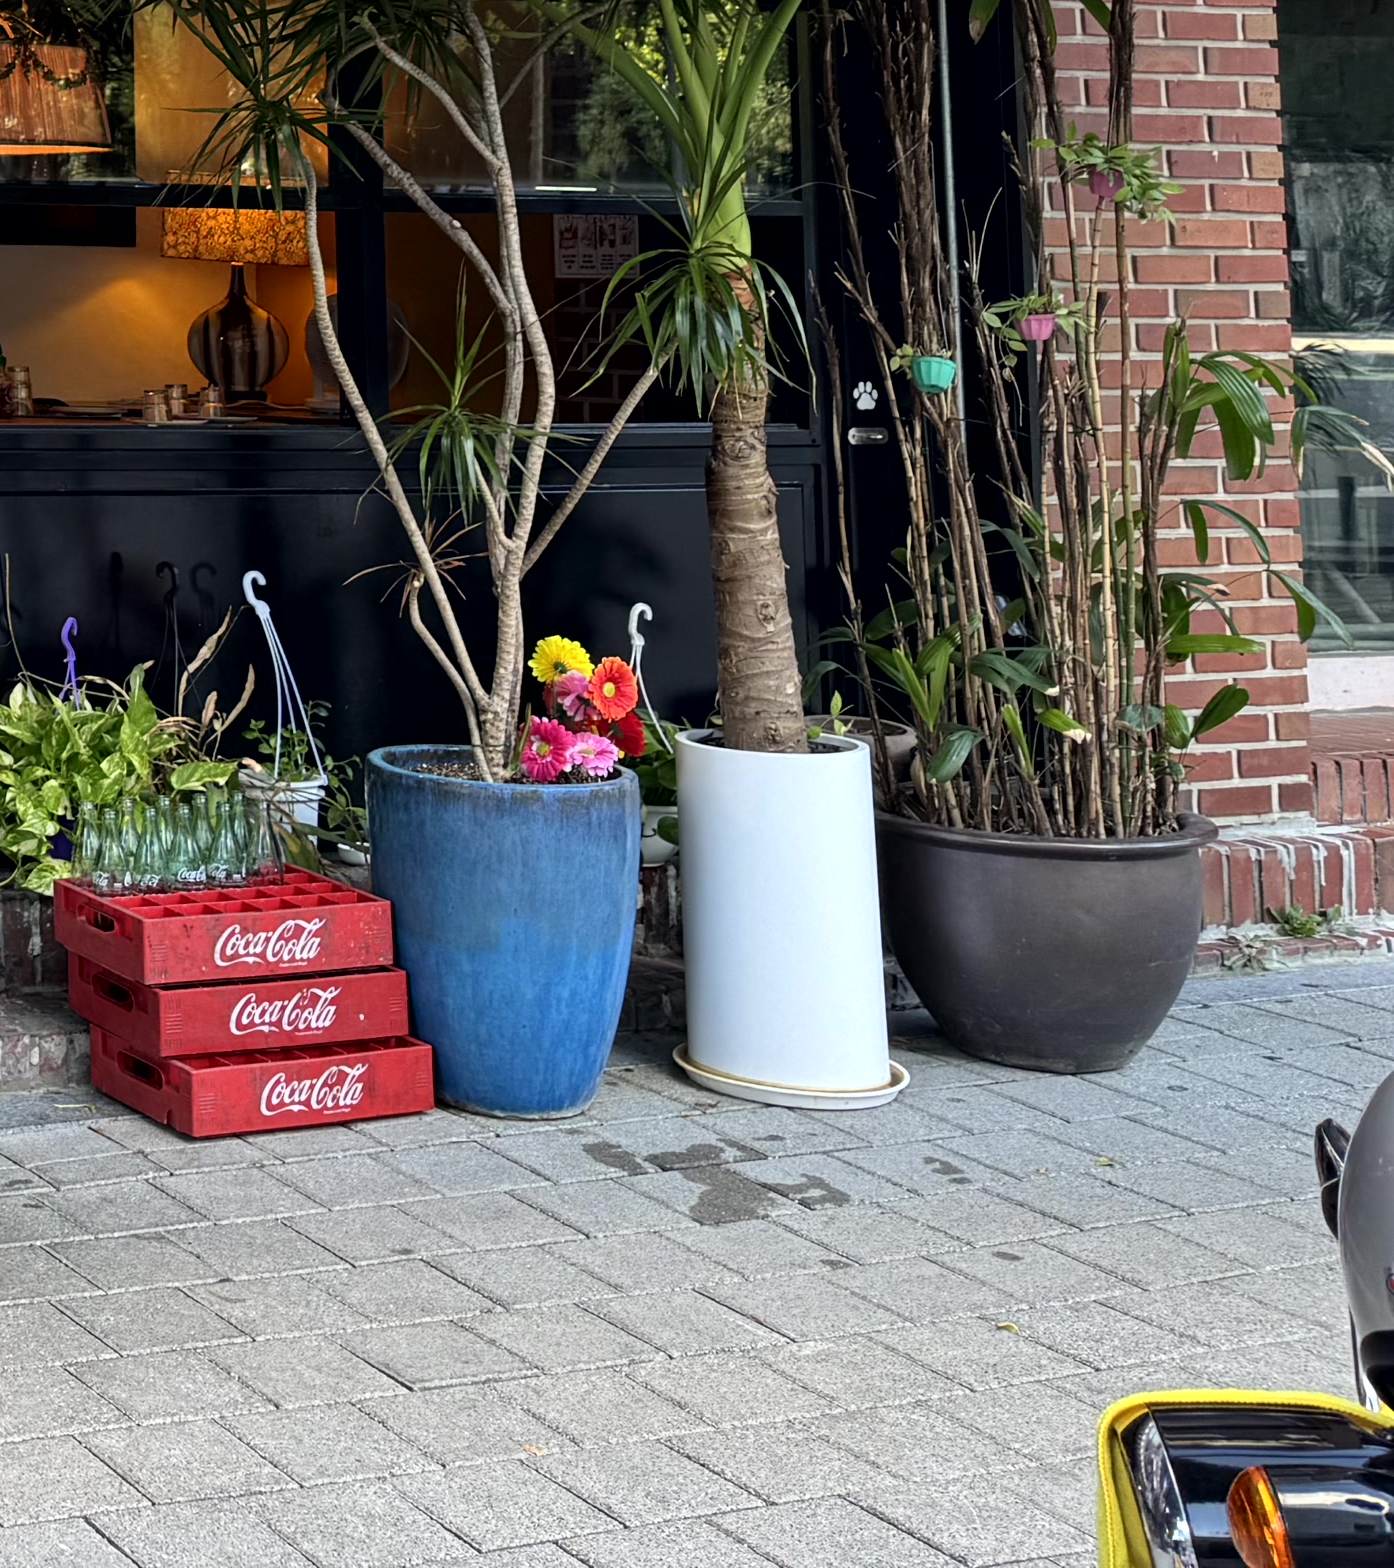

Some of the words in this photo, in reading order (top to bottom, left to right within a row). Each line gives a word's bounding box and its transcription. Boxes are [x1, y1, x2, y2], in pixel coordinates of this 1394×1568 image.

[214, 917, 327, 967] Coca-Cola
[229, 986, 342, 1036] Coca-Cola
[260, 1063, 369, 1116] Coca-Cola
